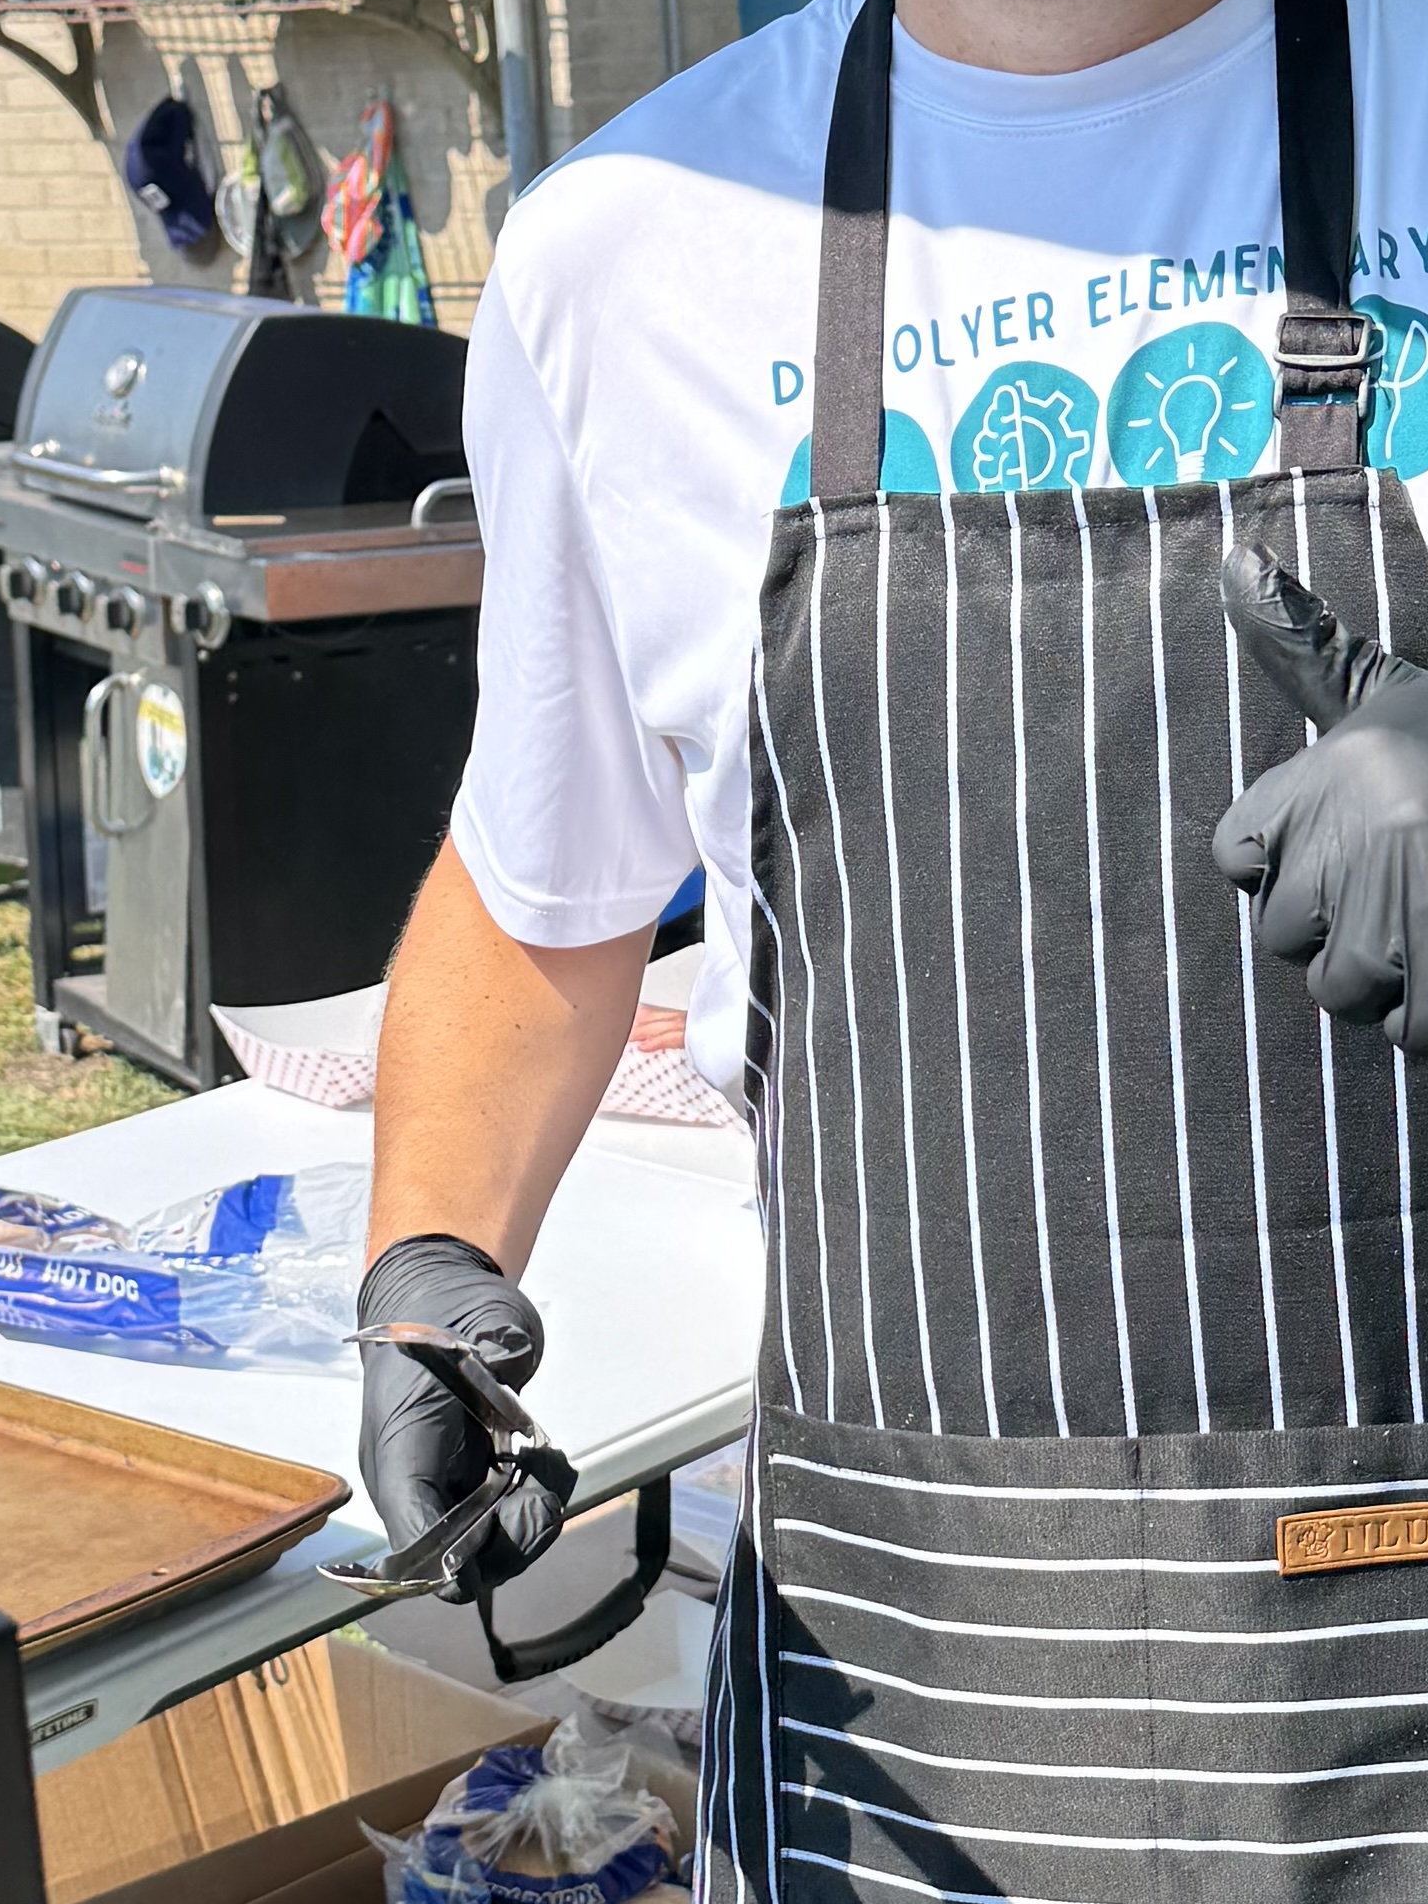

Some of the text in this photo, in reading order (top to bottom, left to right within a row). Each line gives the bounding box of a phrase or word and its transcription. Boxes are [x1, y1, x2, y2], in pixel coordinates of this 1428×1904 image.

[772, 292, 1056, 405] DOLYER
[41, 1259, 93, 1292] HOT
[95, 1272, 140, 1303] DOG
